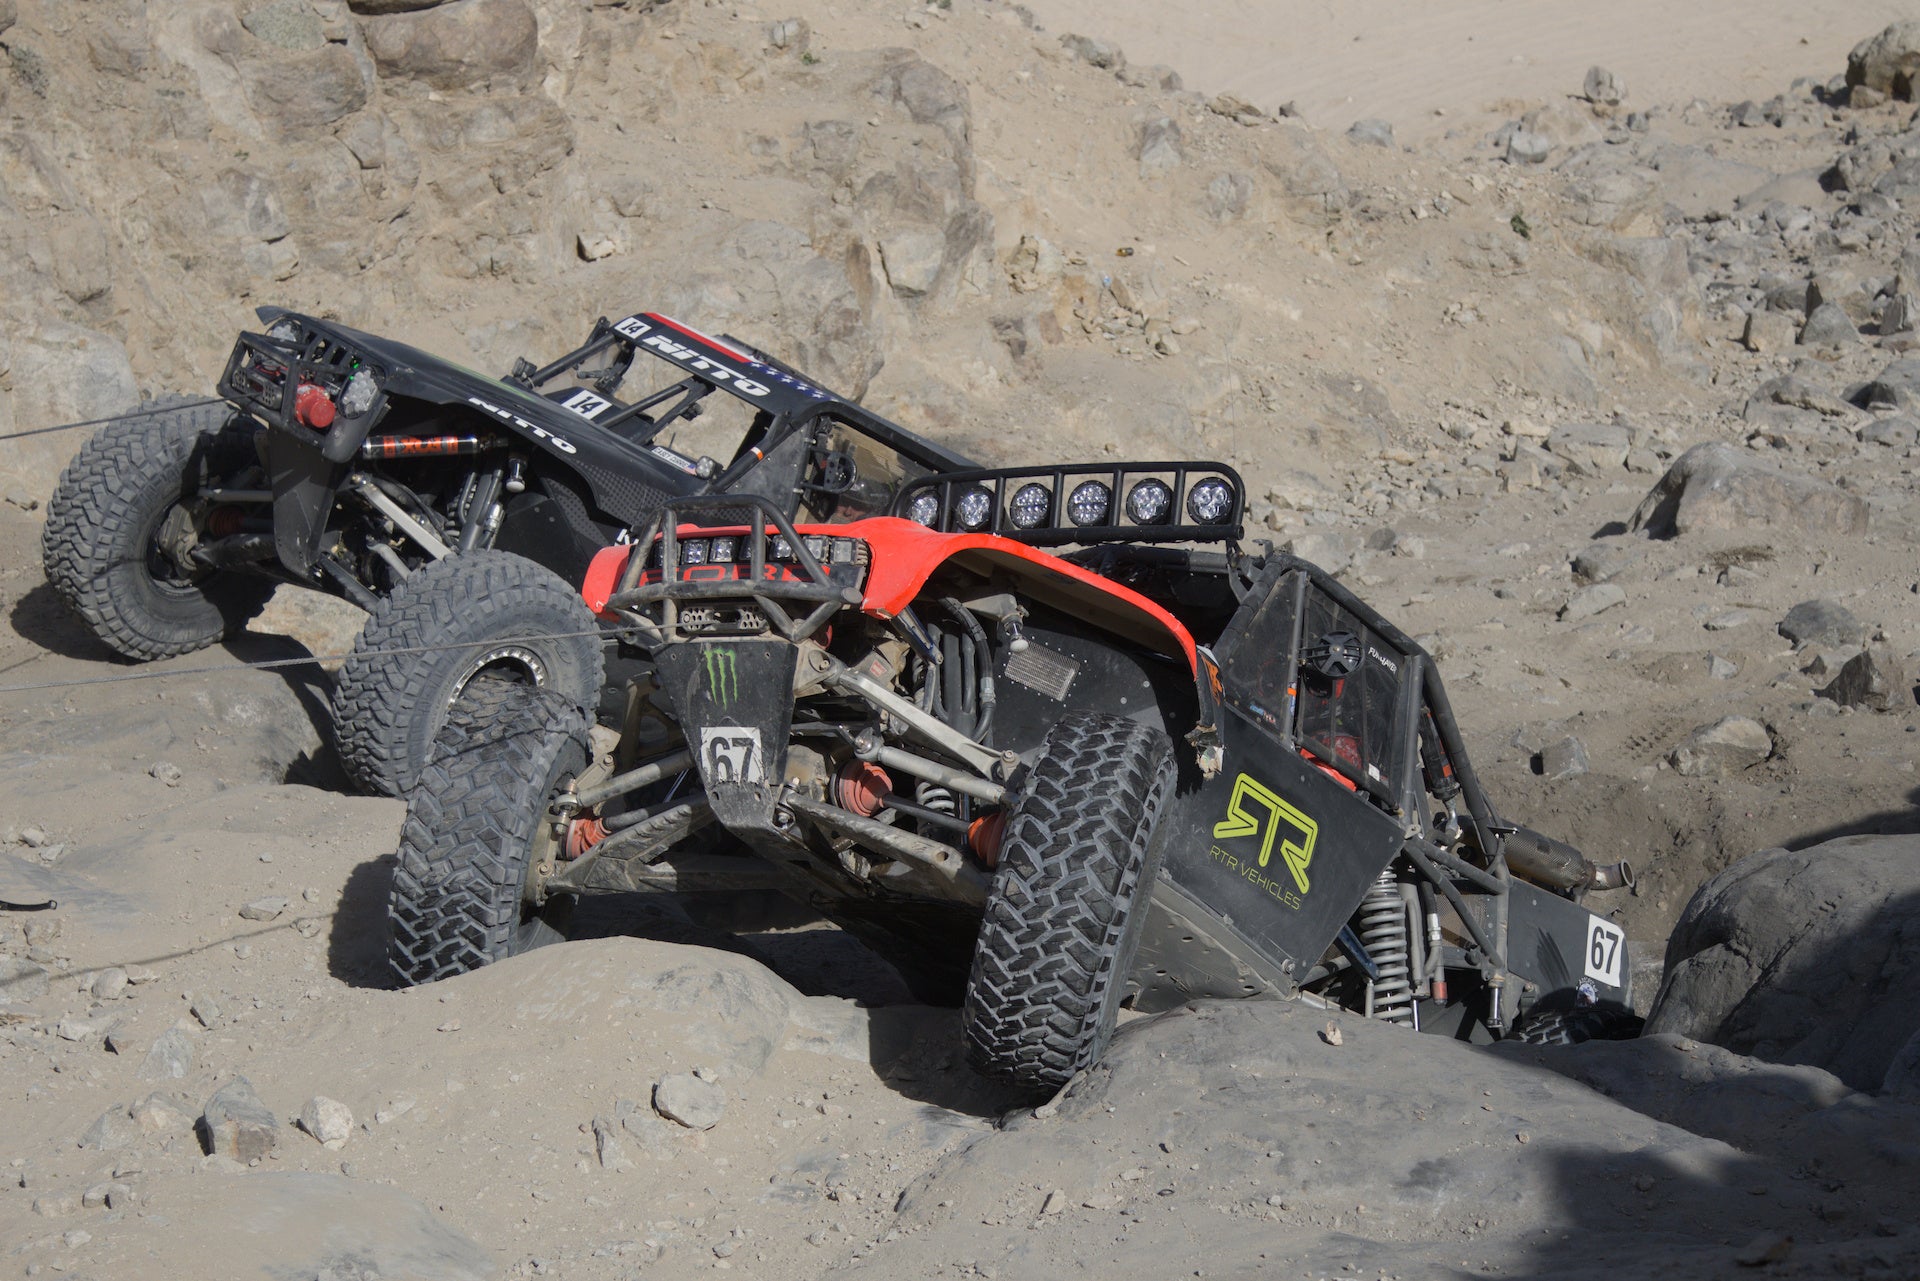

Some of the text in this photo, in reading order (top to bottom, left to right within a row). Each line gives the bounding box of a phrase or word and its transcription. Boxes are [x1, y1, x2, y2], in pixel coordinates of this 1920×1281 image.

[620, 321, 645, 335] 14
[642, 334, 771, 397] NITTO
[468, 397, 577, 454] NITTO
[569, 396, 604, 415] 14
[709, 736, 755, 783] 67
[1209, 845, 1301, 911] RTR VEHICLES
[1591, 925, 1619, 975] 67
